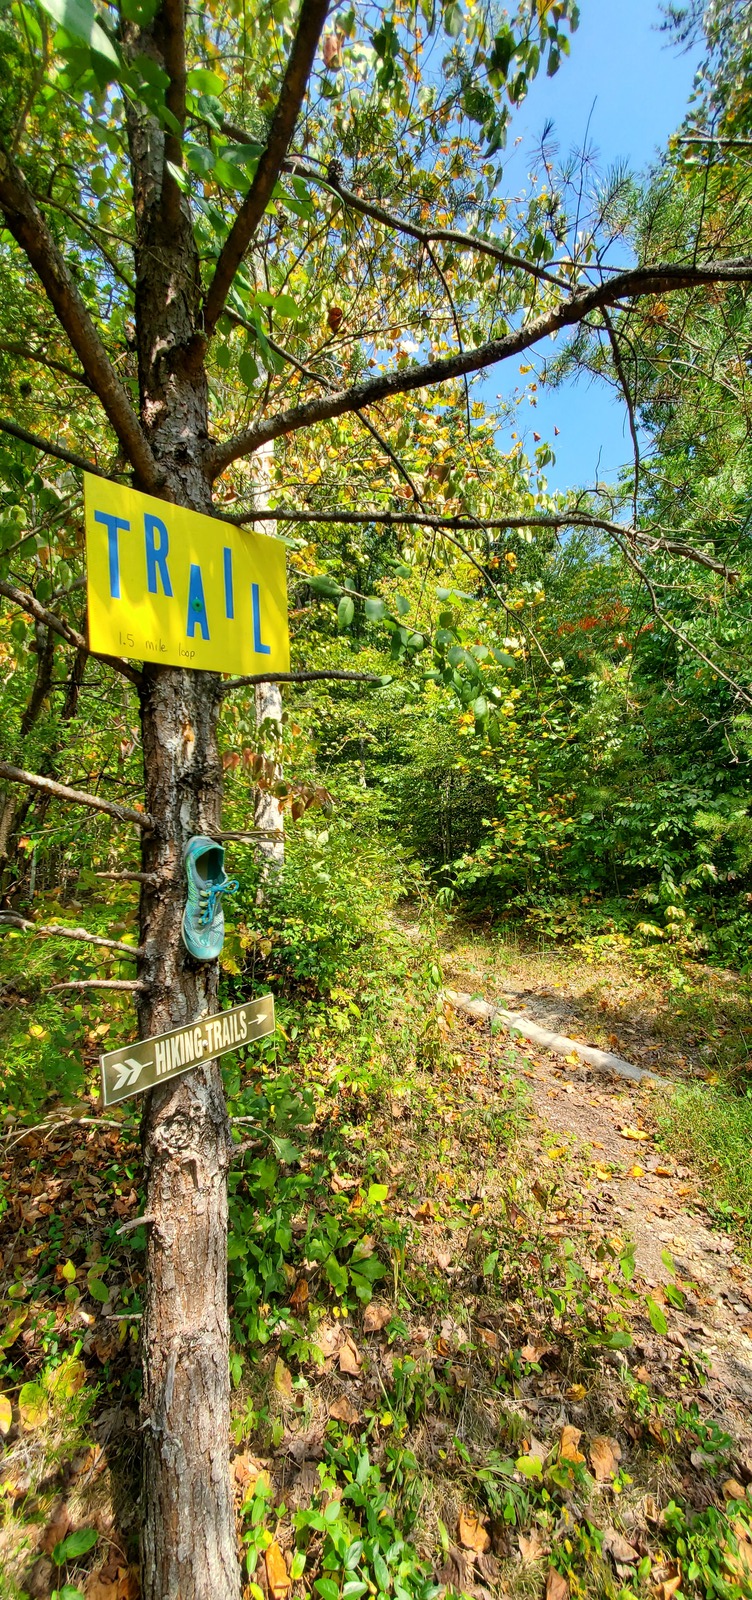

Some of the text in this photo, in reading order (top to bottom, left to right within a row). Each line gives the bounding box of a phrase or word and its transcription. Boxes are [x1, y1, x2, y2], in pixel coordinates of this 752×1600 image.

[94, 509, 271, 655] TRAIL
[119, 631, 196, 660] 1.5 mile loop
[154, 1010, 248, 1076] HIKING TRAILS
